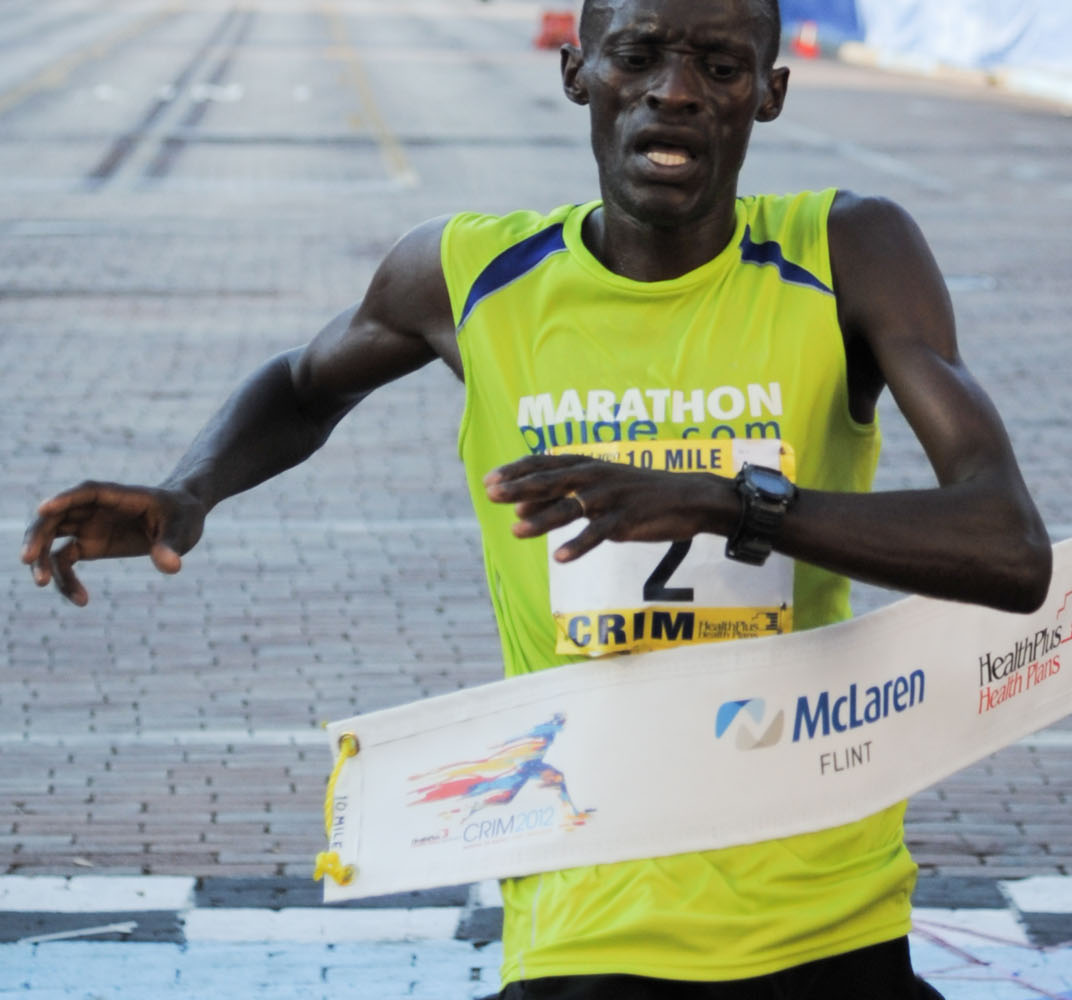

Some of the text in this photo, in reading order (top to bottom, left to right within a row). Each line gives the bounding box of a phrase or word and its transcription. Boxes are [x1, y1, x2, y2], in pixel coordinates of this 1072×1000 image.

[517, 382, 784, 428] MARATHON
[626, 450, 654, 470] 10
[665, 448, 722, 472] MILE
[642, 538, 695, 603] 2
[568, 611, 695, 648] CRIM
[977, 625, 1063, 688] HealthPlus
[792, 668, 926, 743] McLaren
[977, 654, 1062, 715] Health Plans
[819, 740, 873, 776] FLINT
[331, 795, 348, 849] 10 MILE
